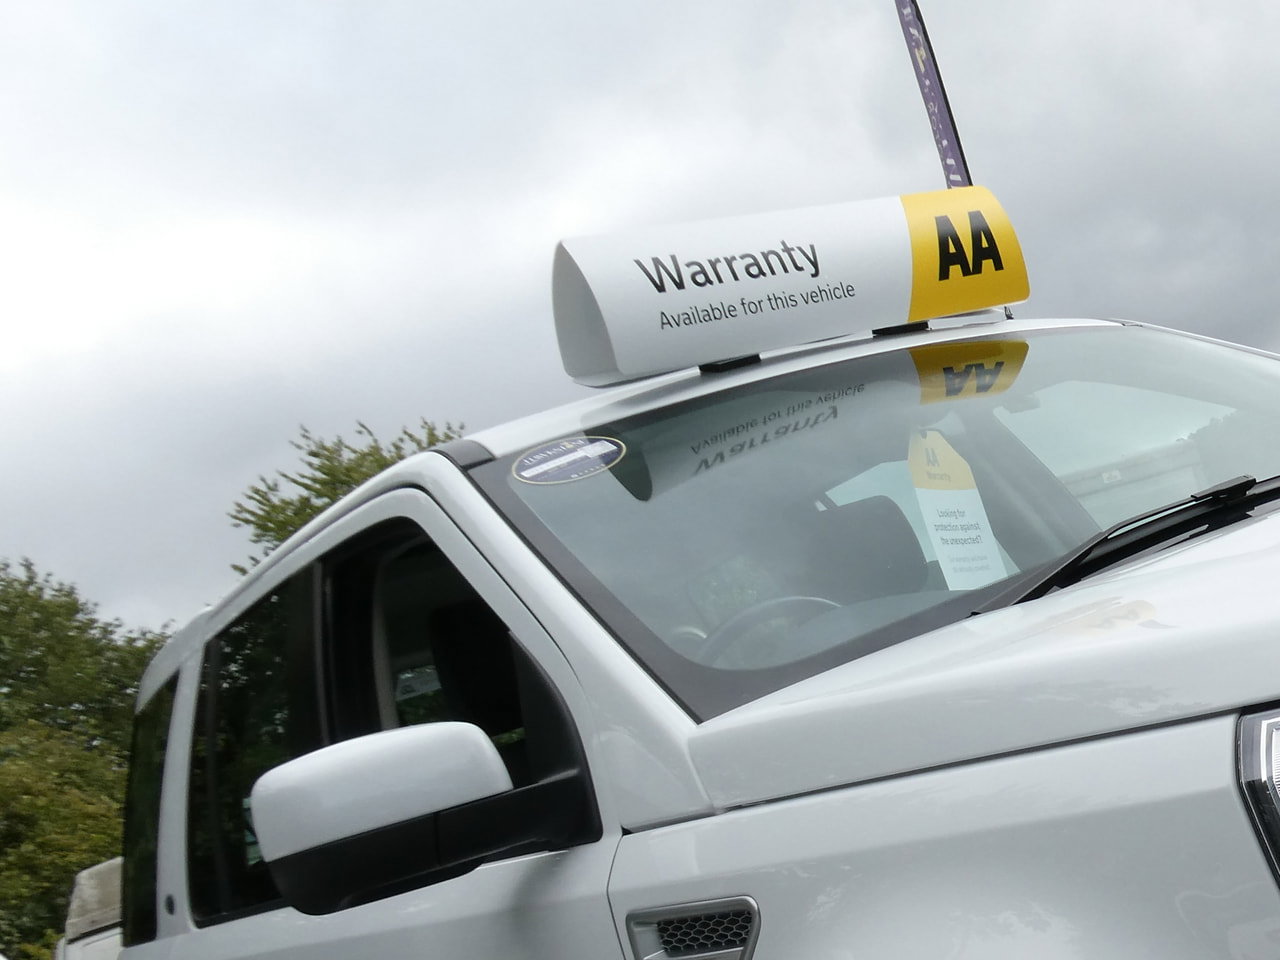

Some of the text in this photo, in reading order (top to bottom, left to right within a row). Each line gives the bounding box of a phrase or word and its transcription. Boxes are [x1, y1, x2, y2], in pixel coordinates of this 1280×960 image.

[935, 210, 1005, 281] AA
[633, 239, 820, 294] Warranty
[659, 281, 856, 330] Available for this vehicle
[934, 521, 982, 533] protection against
[937, 508, 957, 519] Looking
[950, 534, 983, 546] unexpected?
